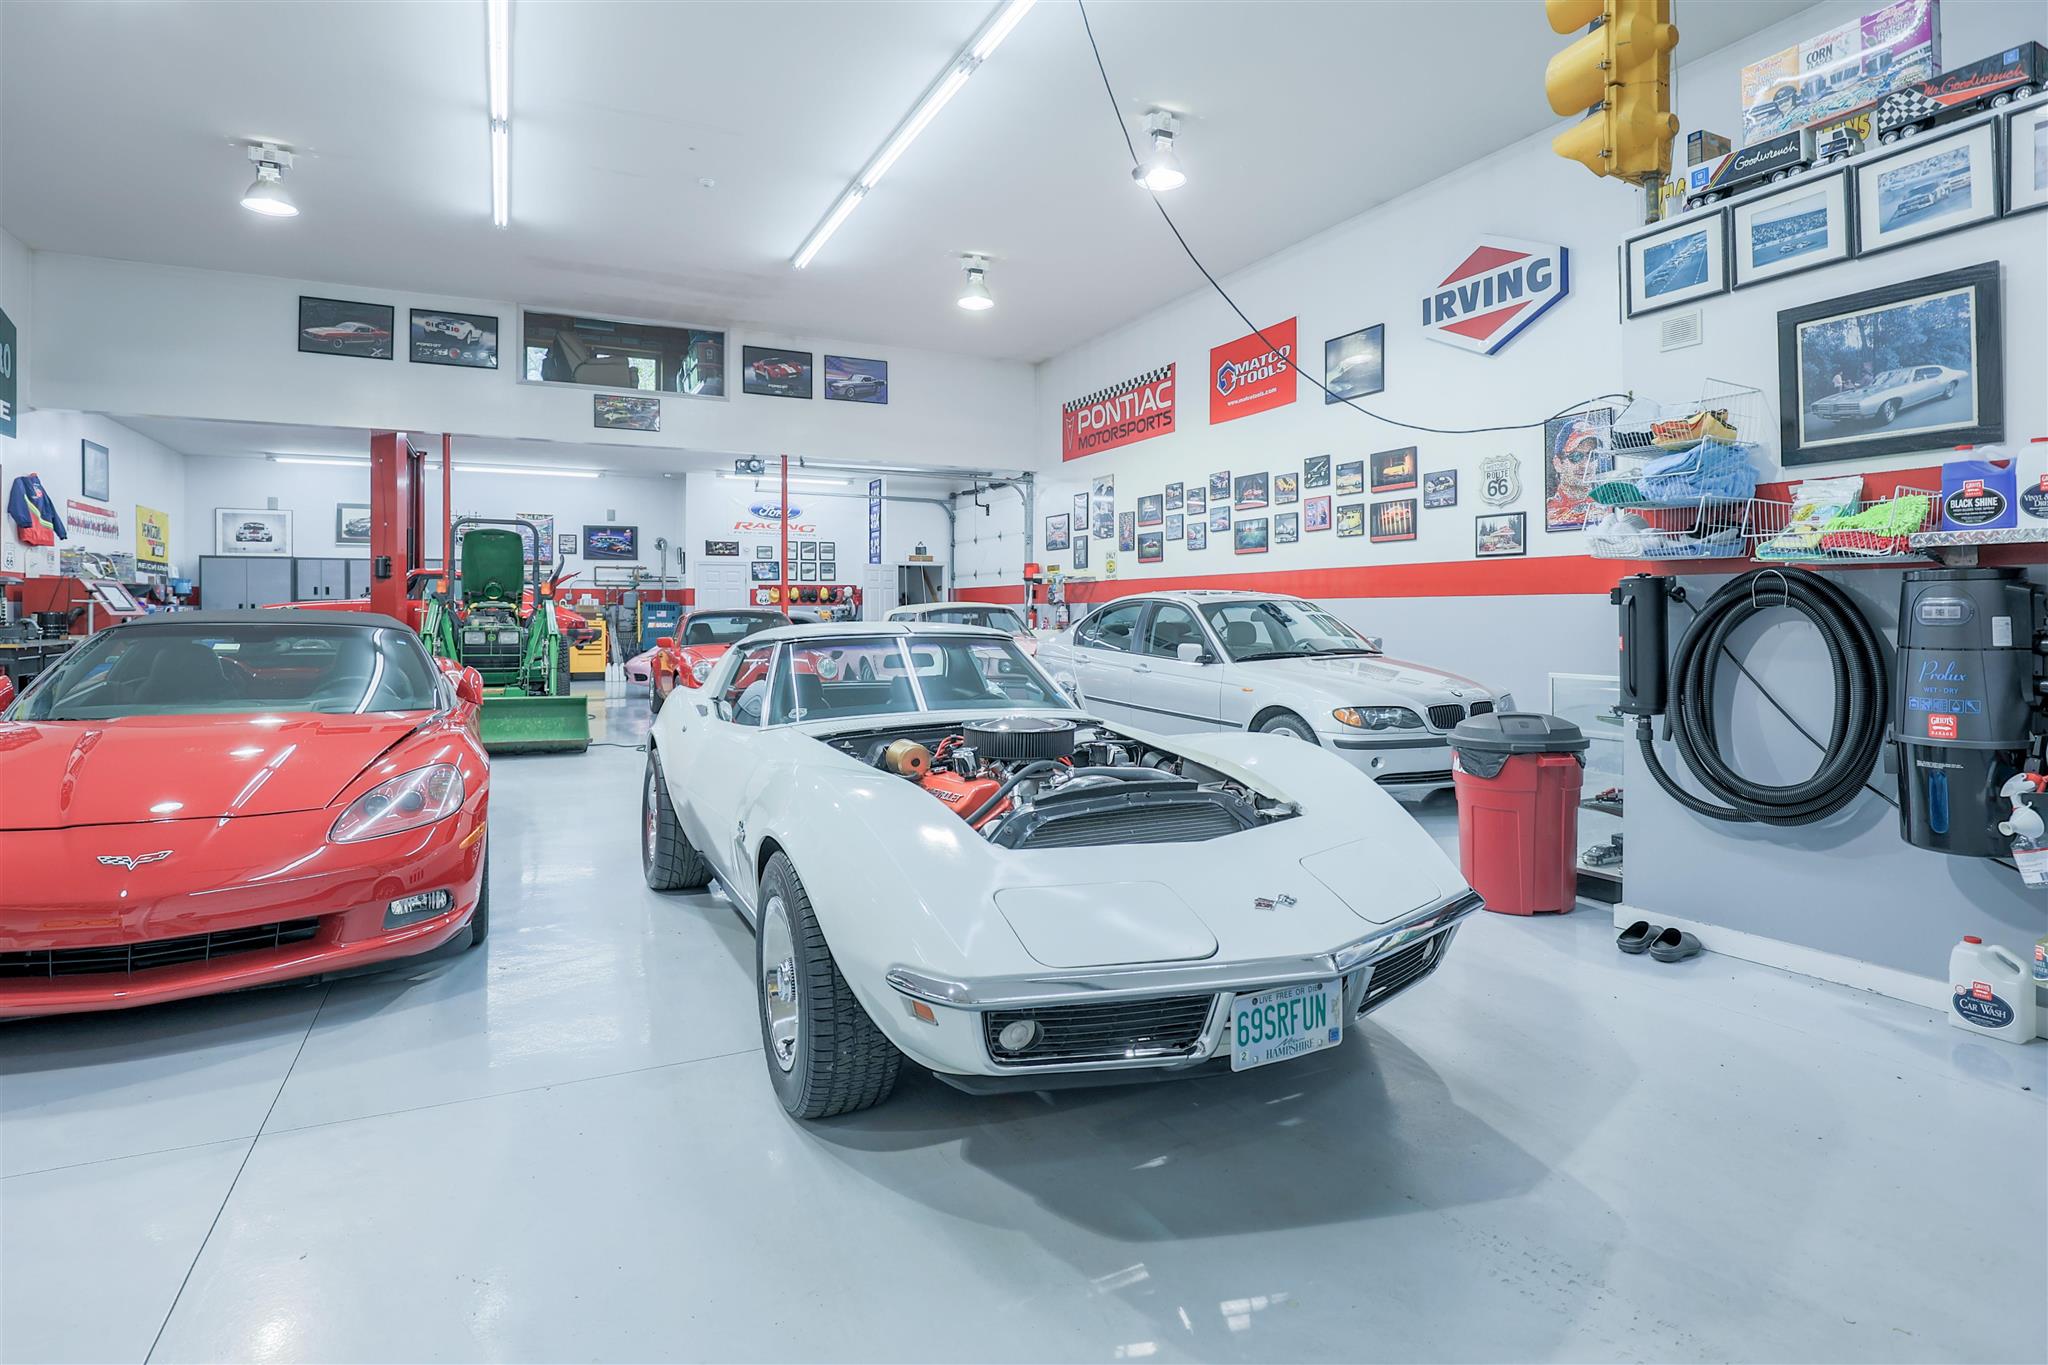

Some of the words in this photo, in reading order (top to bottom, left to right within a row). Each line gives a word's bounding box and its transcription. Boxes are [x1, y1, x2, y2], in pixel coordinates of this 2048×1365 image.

[1806, 44, 1833, 64] CORN
[1941, 63, 2026, 93] Goodwrench
[1734, 141, 1799, 171] Goodwrench
[1422, 257, 1552, 327] IRVING
[1236, 344, 1291, 375] MATCO
[1236, 360, 1288, 386] TOOLS
[1077, 380, 1172, 434] PONTIAC
[1227, 387, 1278, 407] www.matcotools.com
[1078, 410, 1173, 450] MOTORSPORTS
[1486, 469, 1509, 480] ROUTE
[1487, 479, 1509, 497] 66
[1950, 498, 1973, 508] BLACK
[1974, 496, 1998, 507] SHINE
[734, 520, 816, 533] RACNG
[1918, 660, 1968, 683] Prolux
[1930, 716, 1954, 726] GRIOT'S
[1258, 995, 1274, 1004] LIVE
[1275, 990, 1293, 1000] FREE
[1295, 986, 1305, 996] OR
[1307, 984, 1319, 993] DIE
[1959, 998, 1978, 1012] CAR
[1980, 1004, 2007, 1019] WASH
[1237, 993, 1327, 1047] 69SRFUN
[1240, 1051, 1247, 1062] 2
[1266, 1038, 1314, 1060] HAMPSHIRE
